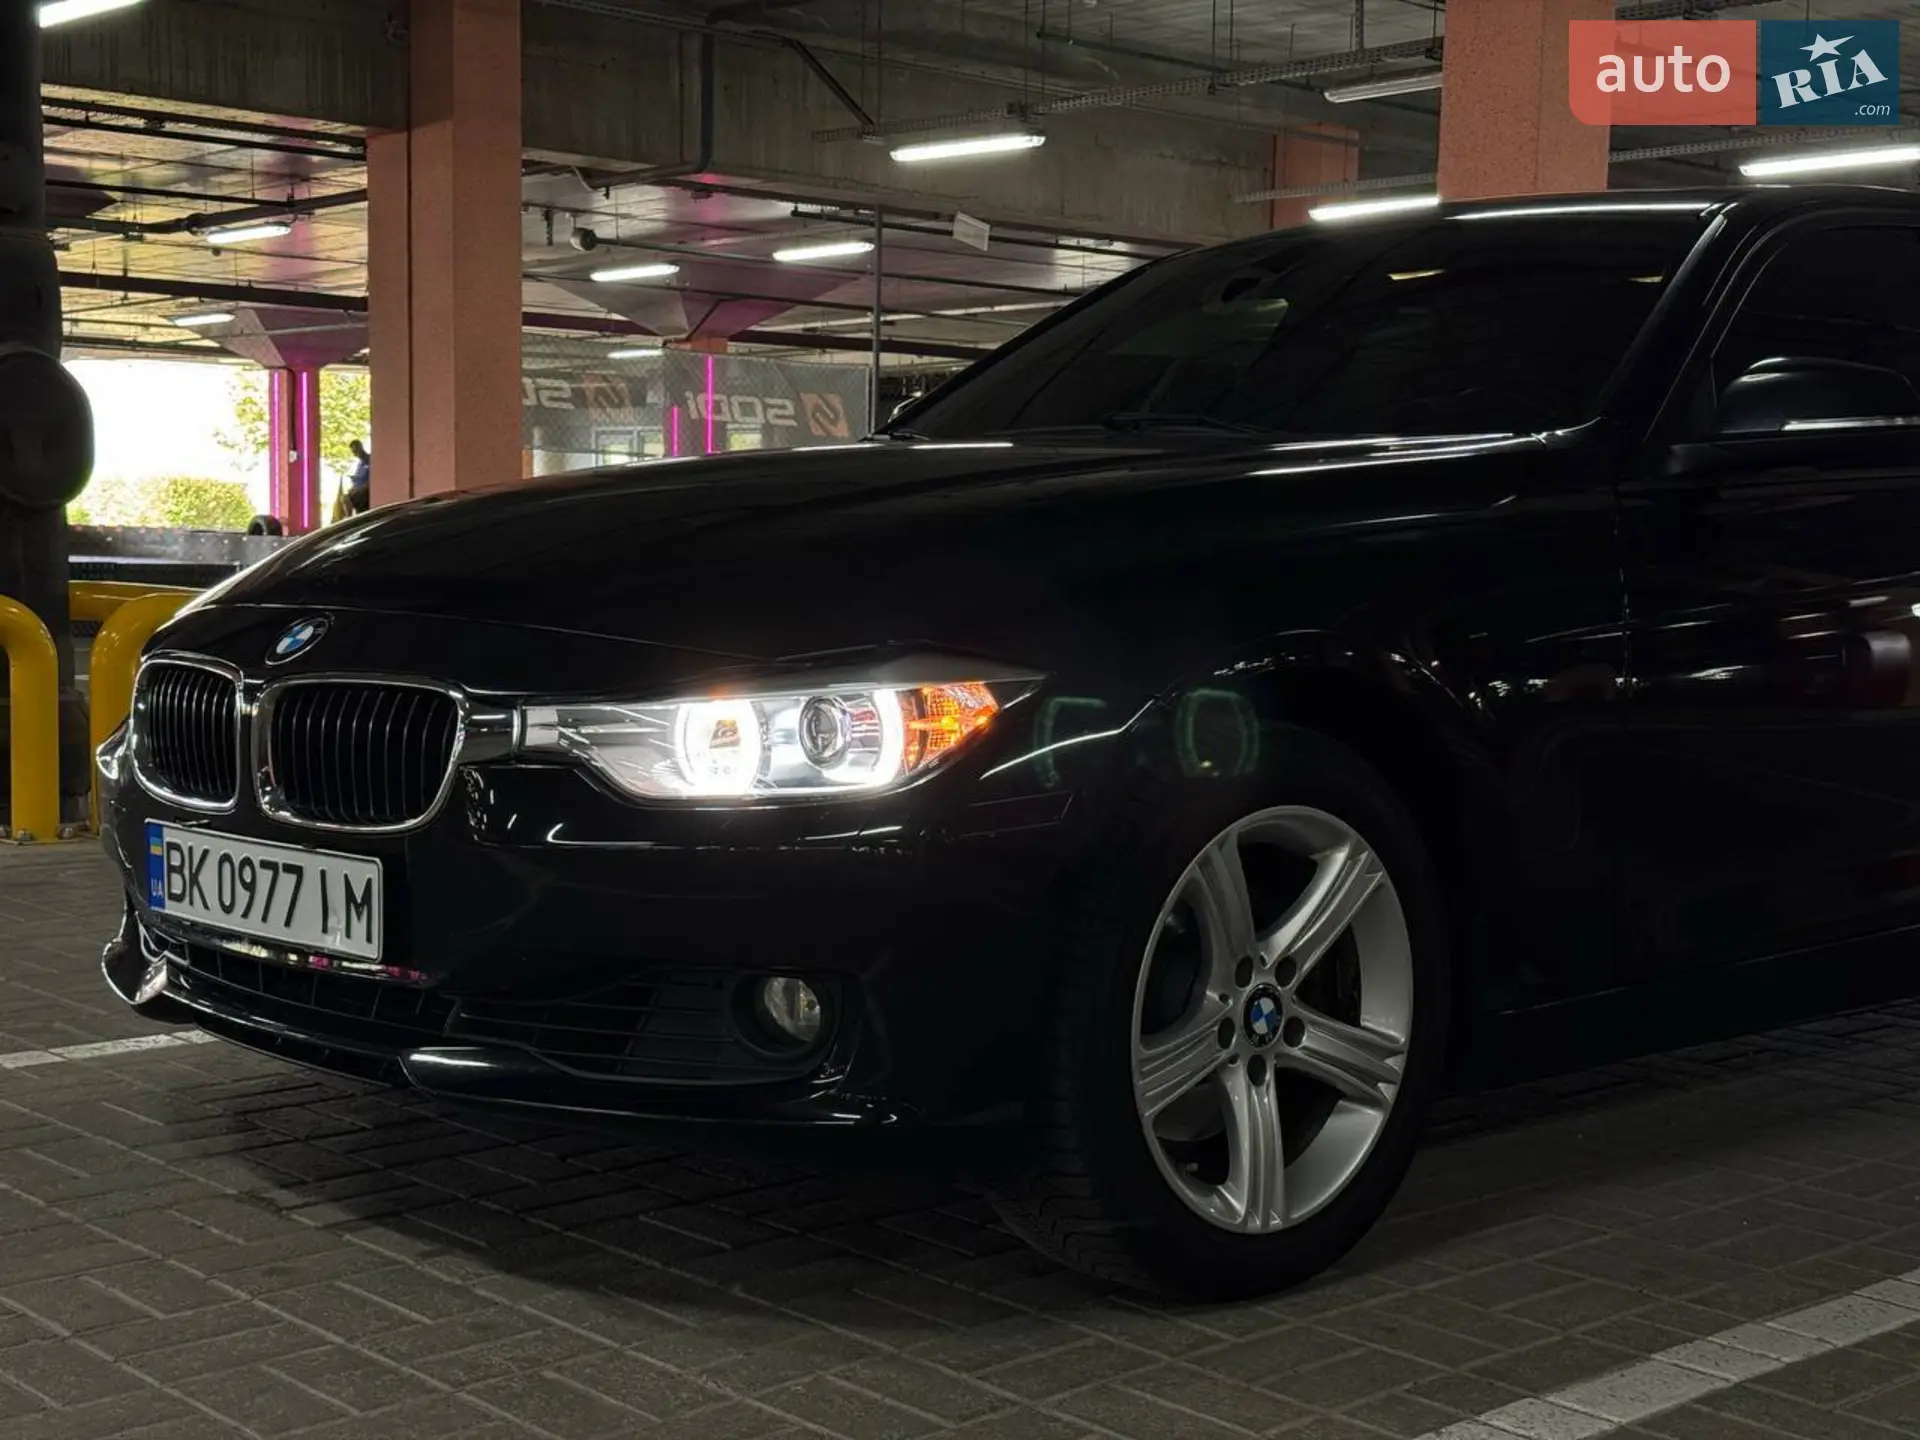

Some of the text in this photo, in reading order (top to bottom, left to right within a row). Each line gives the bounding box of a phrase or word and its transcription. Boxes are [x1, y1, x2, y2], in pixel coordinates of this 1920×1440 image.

[151, 878, 164, 897] UA
[165, 841, 373, 944] BK 0977 IM
